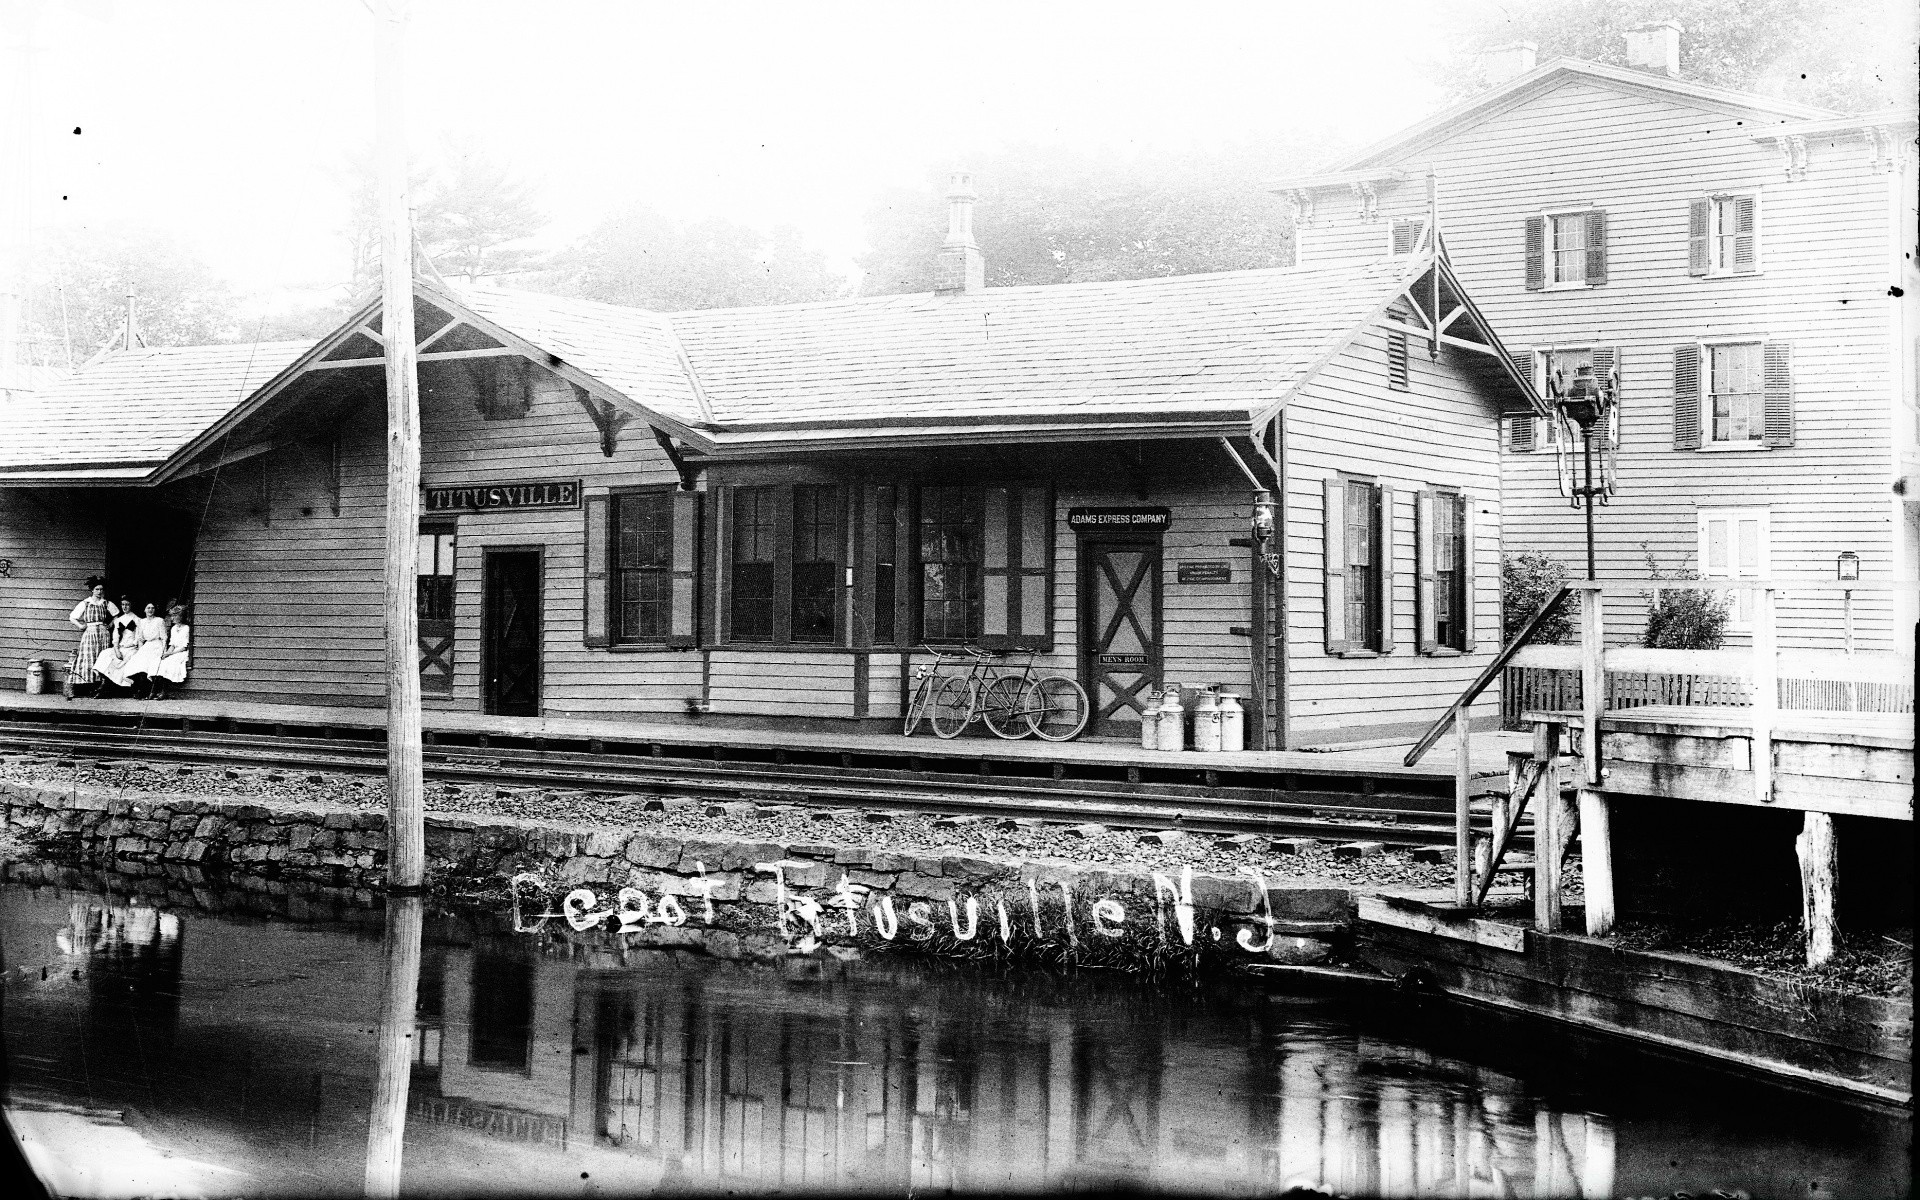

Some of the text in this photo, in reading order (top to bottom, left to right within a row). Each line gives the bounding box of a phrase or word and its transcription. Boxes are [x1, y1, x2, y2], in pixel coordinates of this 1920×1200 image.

[431, 484, 573, 508] TITUSVILLE
[1071, 514, 1167, 524] ADAMS EXPRESS COMPANY
